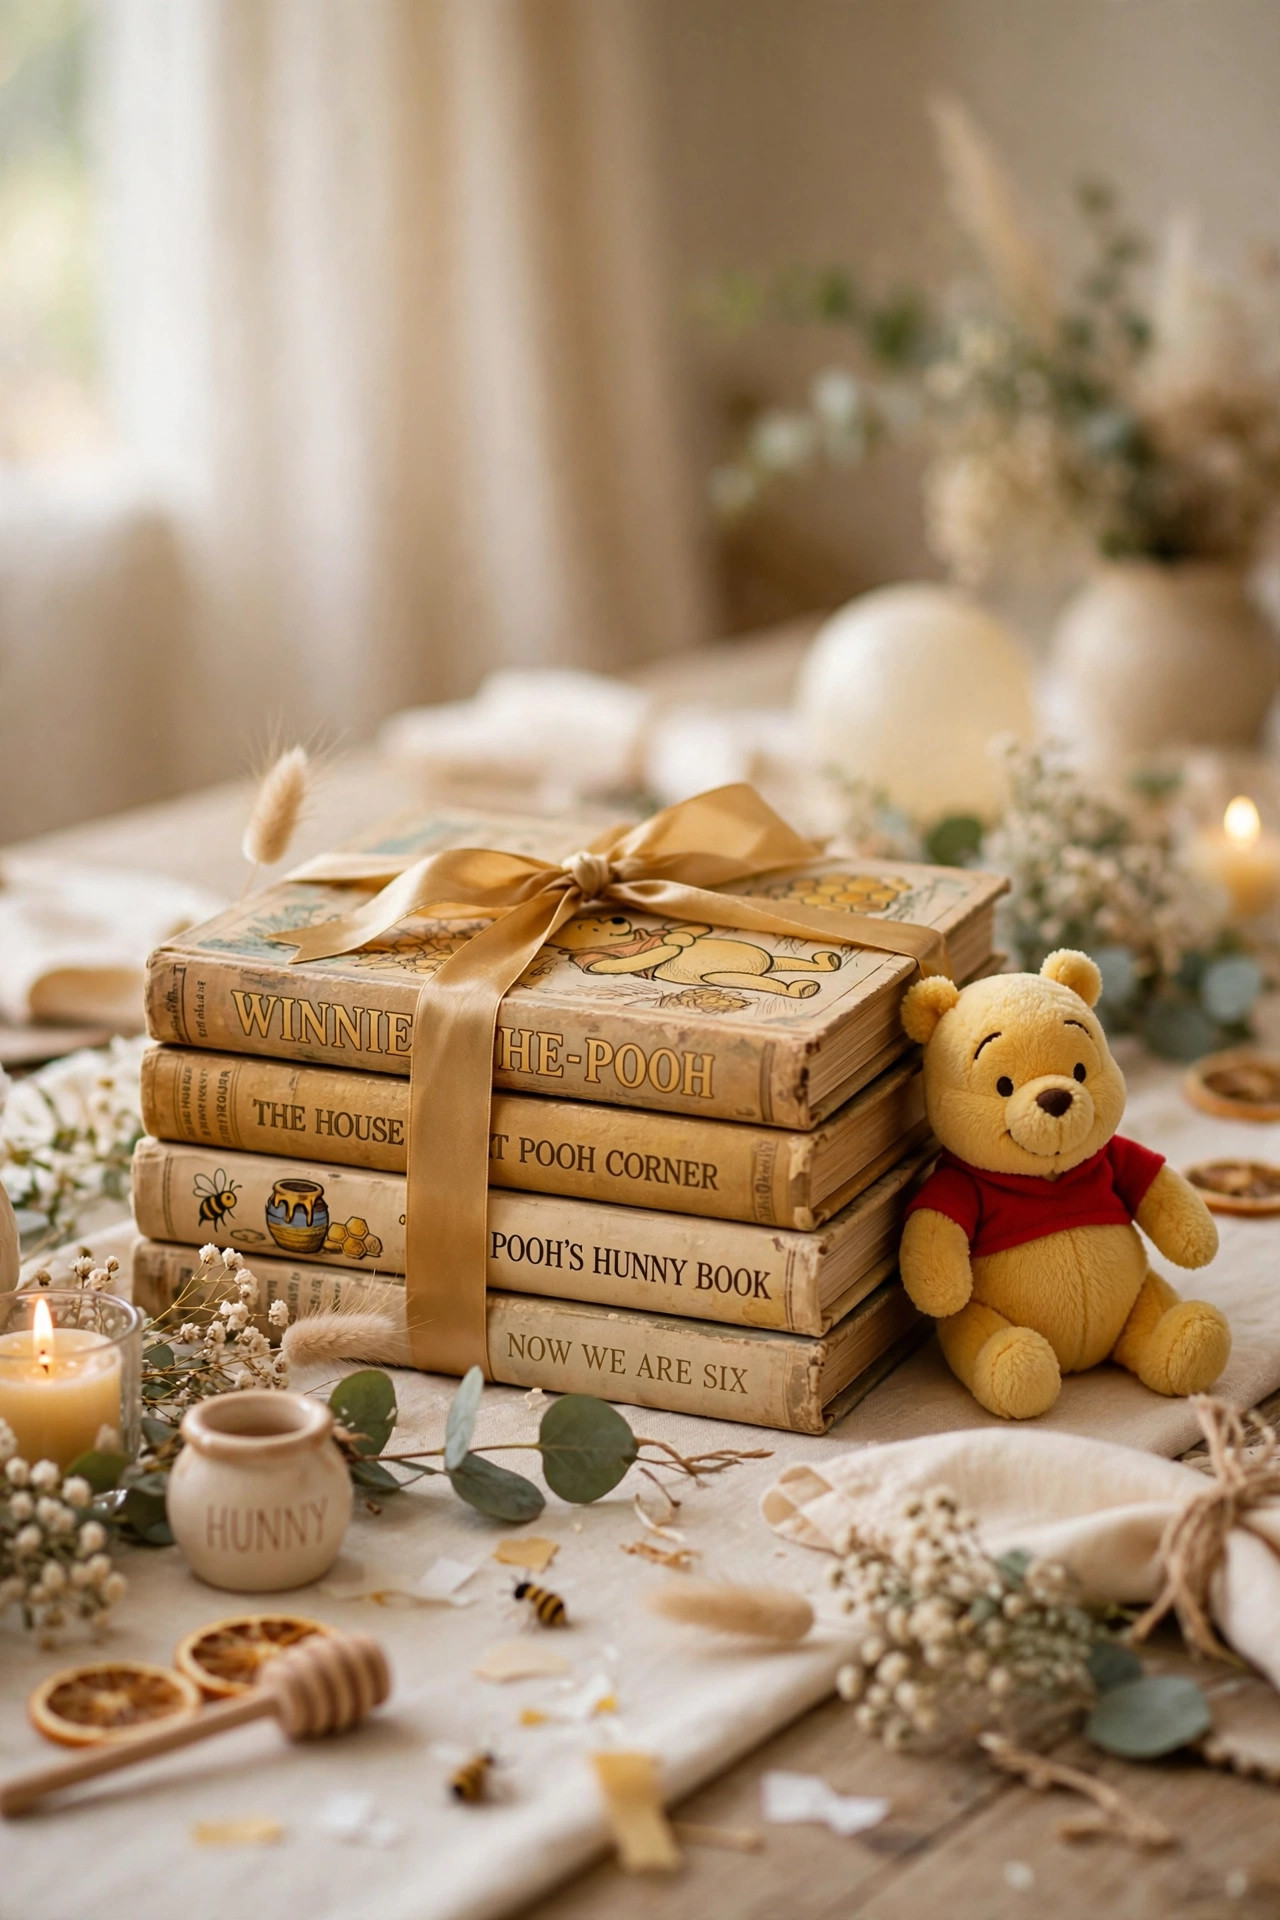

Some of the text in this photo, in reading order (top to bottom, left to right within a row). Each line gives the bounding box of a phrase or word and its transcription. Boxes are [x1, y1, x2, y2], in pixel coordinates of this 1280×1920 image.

[231, 989, 413, 1057] WINNIE
[495, 1026, 715, 1099] HE-POOH
[253, 1098, 306, 1132] THE
[315, 1108, 405, 1146] HOUSE
[519, 1136, 596, 1173] POOH
[605, 1149, 719, 1191] CORNER
[490, 1231, 772, 1300] POOH'S HUNNY BOOK
[507, 1332, 749, 1394] NOW WE ARE SIX
[205, 1498, 328, 1553] HUNNY
